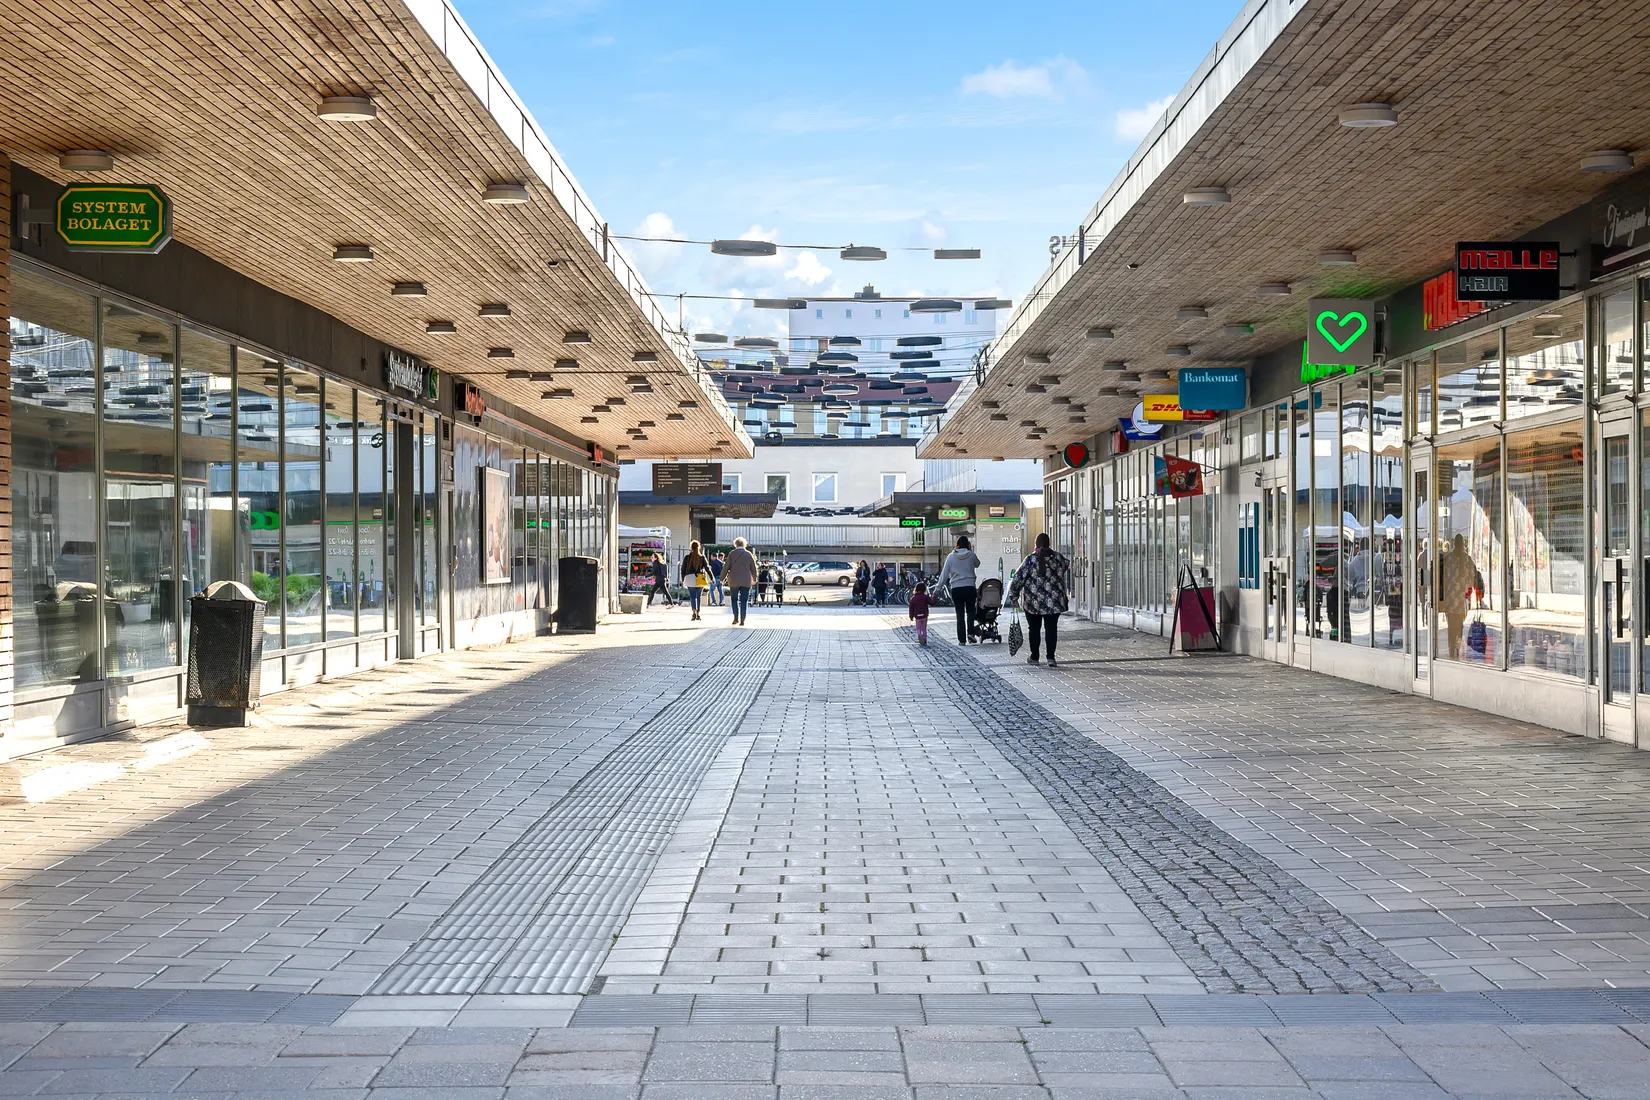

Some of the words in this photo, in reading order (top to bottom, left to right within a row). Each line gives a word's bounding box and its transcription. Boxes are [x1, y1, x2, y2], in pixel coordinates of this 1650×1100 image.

[72, 201, 146, 214] SYSTEM
[67, 218, 152, 231] BOLAGET
[1184, 372, 1239, 383] Bankomat
[942, 509, 966, 517] coop
